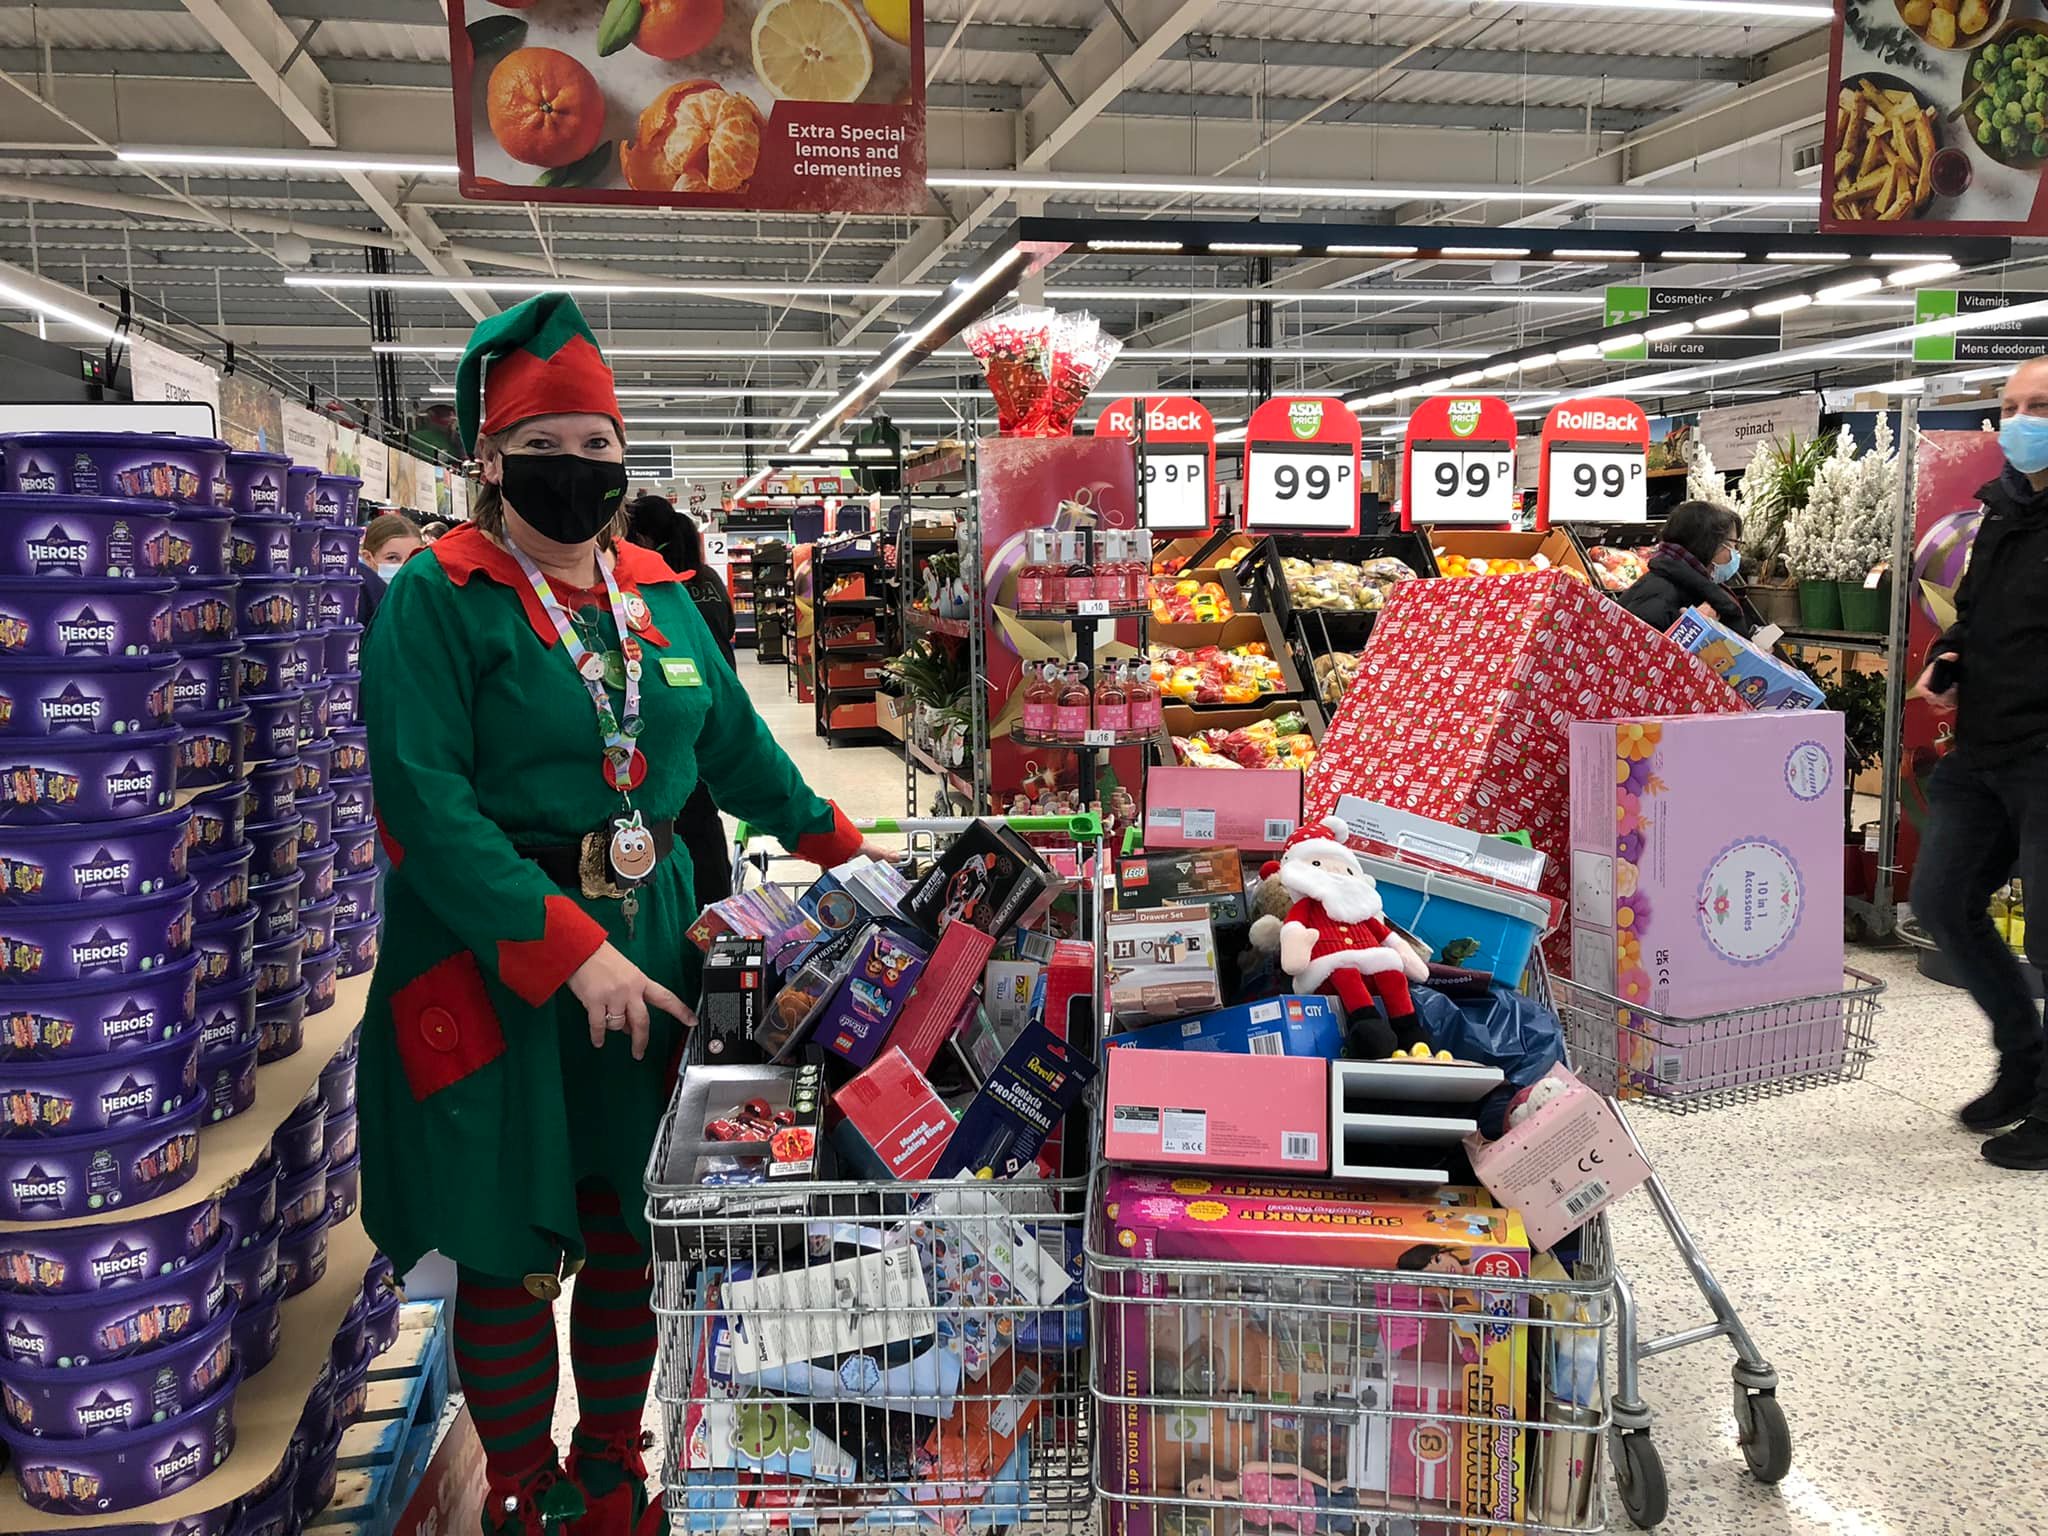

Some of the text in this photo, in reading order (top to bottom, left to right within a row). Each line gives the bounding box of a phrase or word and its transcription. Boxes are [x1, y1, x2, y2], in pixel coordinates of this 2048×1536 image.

[788, 123, 904, 142] Extra Special
[795, 140, 898, 159] lemons and
[793, 160, 902, 178] clementines
[1964, 296, 2009, 306] Vitamins
[1654, 343, 1704, 353] Hair care
[1961, 343, 2045, 354] Mens deodorant
[1288, 403, 1324, 416] ASDA
[1447, 402, 1482, 415] ASDA
[1293, 416, 1319, 425] PRICE
[1452, 414, 1476, 423] PRICE
[1556, 410, 1638, 431] RollBack
[1735, 420, 1774, 439] spinach
[19, 477, 55, 491] HEROES
[1273, 464, 1332, 500] 99
[1434, 462, 1490, 498] 99
[1573, 464, 1625, 497] 99
[251, 490, 279, 502] HEROES
[315, 503, 338, 514] EROES
[28, 544, 88, 560] HEROES
[322, 554, 348, 564] HEROES
[59, 624, 114, 641] HEROES
[172, 682, 206, 696] EROES
[42, 700, 100, 717] HEROES
[107, 775, 152, 793] HEROES
[74, 864, 129, 884] HEROES
[1125, 867, 1145, 879] LEGO
[1757, 881, 1768, 895] 10
[335, 902, 357, 915] EROES
[995, 876, 1032, 925] NIGHT RACER
[1744, 870, 1755, 932] Accessories
[1757, 898, 1768, 908] in
[1140, 911, 1169, 921] Drawer
[1170, 911, 1184, 919] Set
[72, 942, 129, 962] HEROES
[745, 991, 753, 1041] TECHNIC
[1305, 1005, 1323, 1017] CITY
[103, 1012, 154, 1034] HEROES
[200, 1022, 236, 1042] HEROES
[1027, 1056, 1055, 1083] Revell
[102, 1087, 153, 1110] HEROES
[989, 1080, 1051, 1129] PROFESSIONAL
[1011, 1082, 1043, 1110] Contacta
[12, 1181, 67, 1198] HEROES
[1238, 1210, 1403, 1227] SUPERMARKET
[92, 1251, 148, 1276] HEROES
[6, 1333, 45, 1352] HEROES
[78, 1402, 132, 1424] HEROES
[1128, 1431, 1139, 1464] YOUR
[154, 1447, 201, 1479] HEROES
[1129, 1469, 1139, 1484] UP
